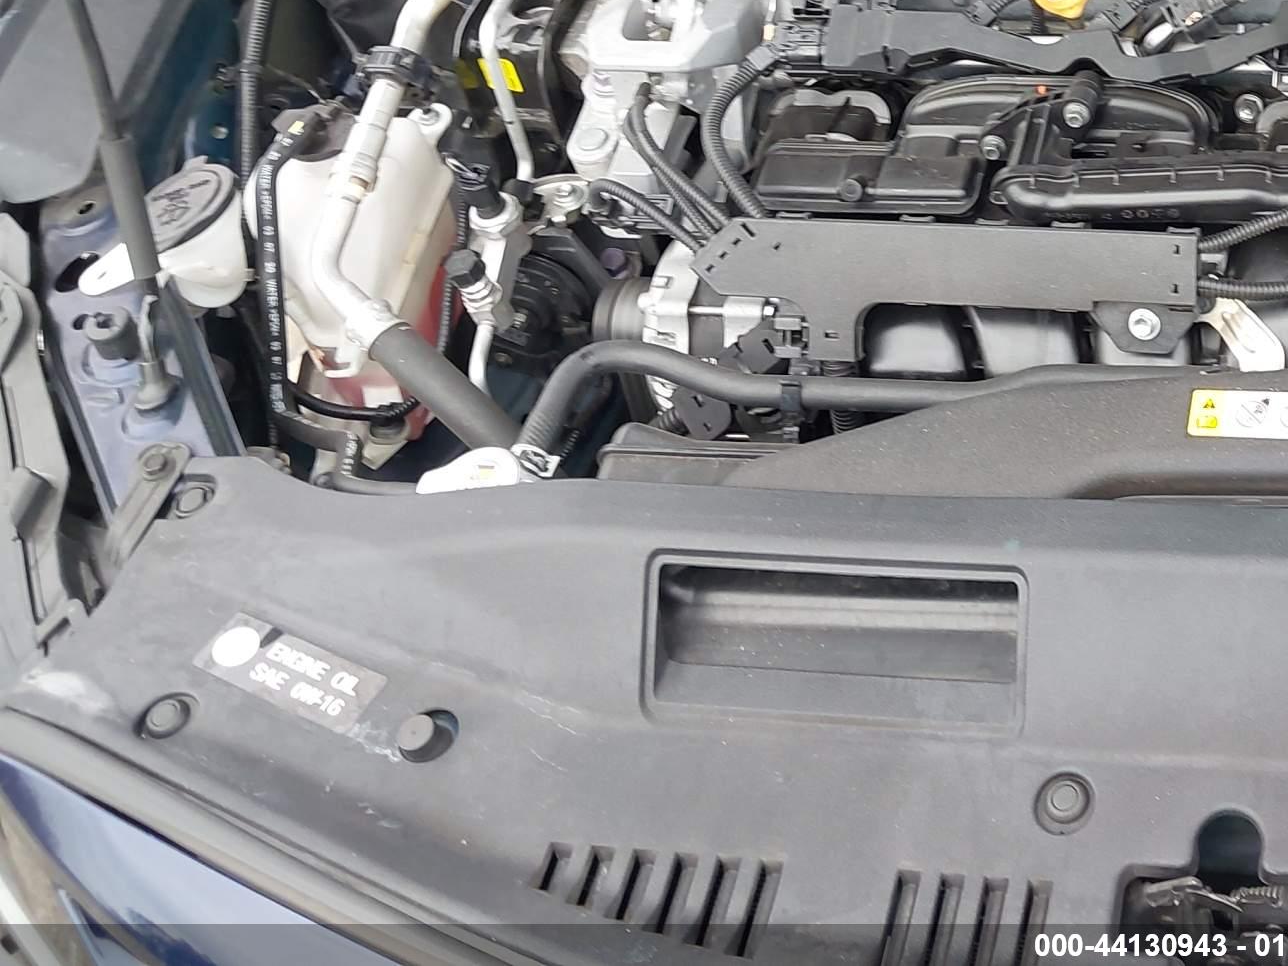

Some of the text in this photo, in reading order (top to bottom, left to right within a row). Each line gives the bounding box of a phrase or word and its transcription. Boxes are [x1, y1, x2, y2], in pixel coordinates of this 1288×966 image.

[250, 662, 290, 691] SAE
[266, 642, 359, 697] ENGINE OIL
